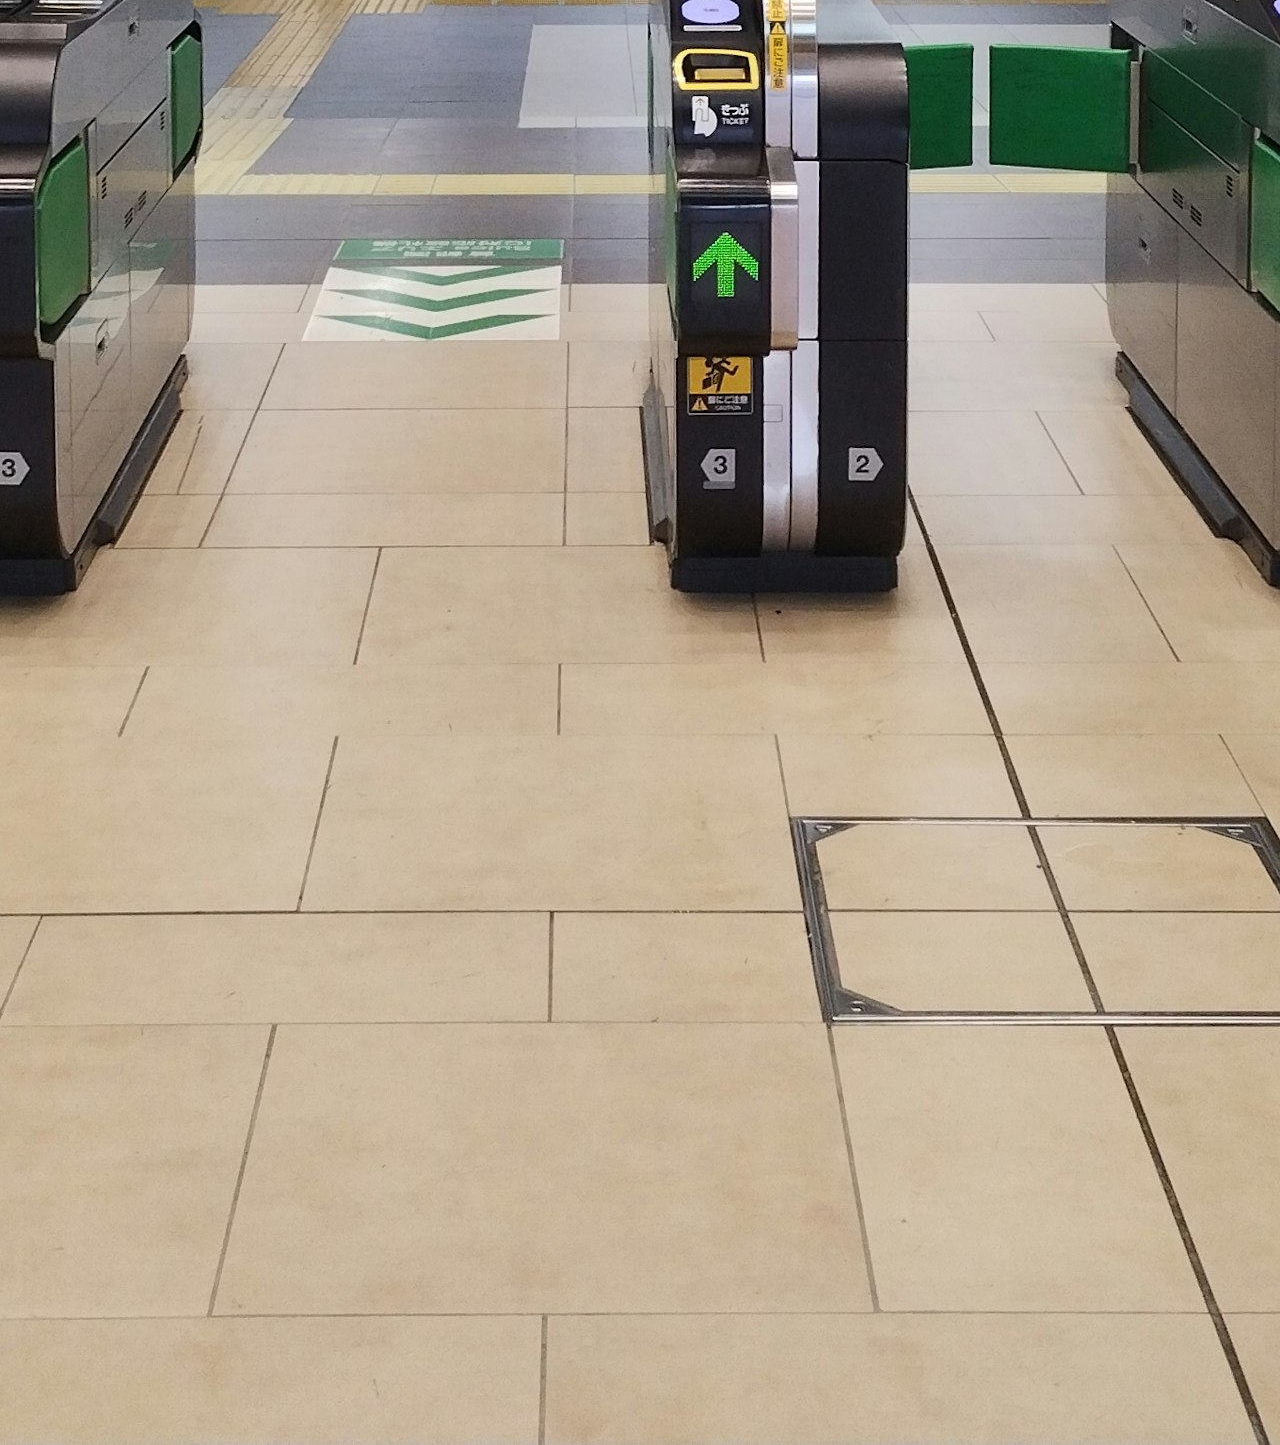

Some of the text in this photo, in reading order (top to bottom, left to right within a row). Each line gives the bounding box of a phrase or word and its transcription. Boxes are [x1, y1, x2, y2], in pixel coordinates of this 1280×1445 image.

[721, 103, 750, 116] きっぷ
[1, 458, 17, 477] 3
[713, 455, 729, 474] 3
[854, 455, 870, 474] 2
